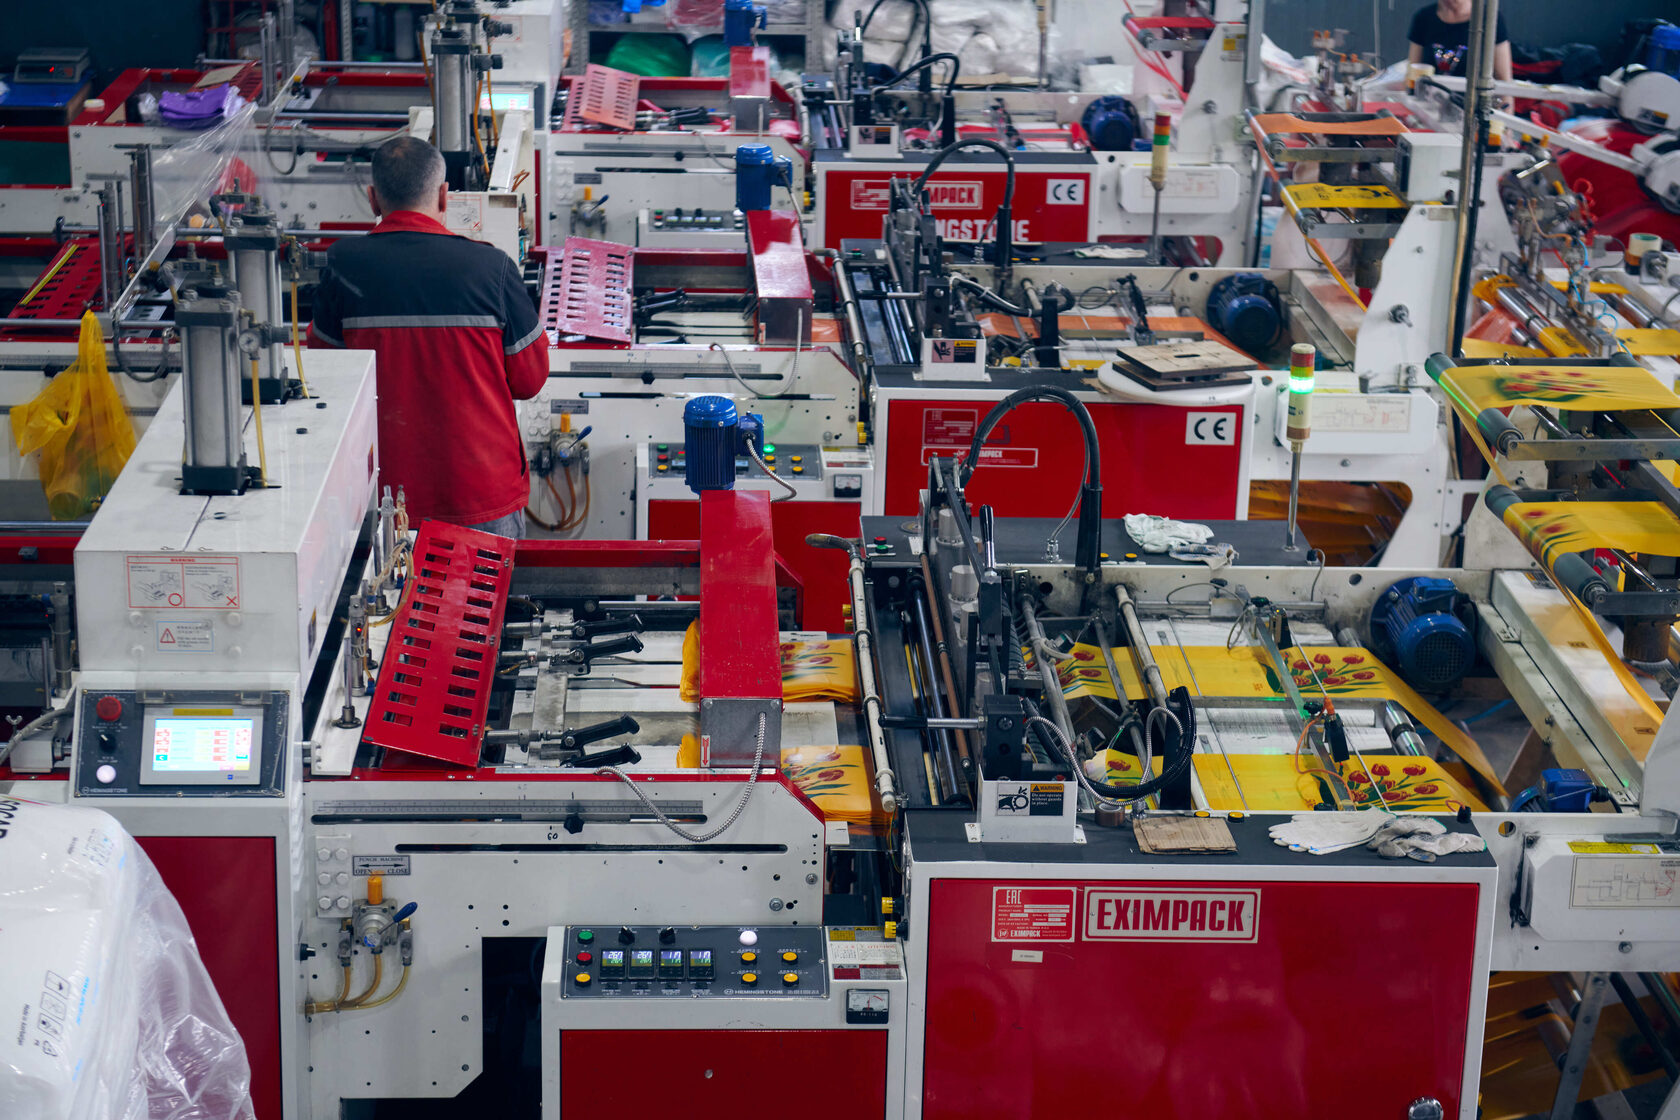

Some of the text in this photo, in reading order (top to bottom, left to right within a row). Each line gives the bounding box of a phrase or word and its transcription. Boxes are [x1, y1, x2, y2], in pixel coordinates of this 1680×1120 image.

[1053, 183, 1078, 201] CE
[1194, 417, 1227, 441] CE
[1006, 889, 1022, 905] EAC
[1097, 898, 1246, 932] EXIMPACK
[1010, 930, 1041, 938] EXIMPACK
